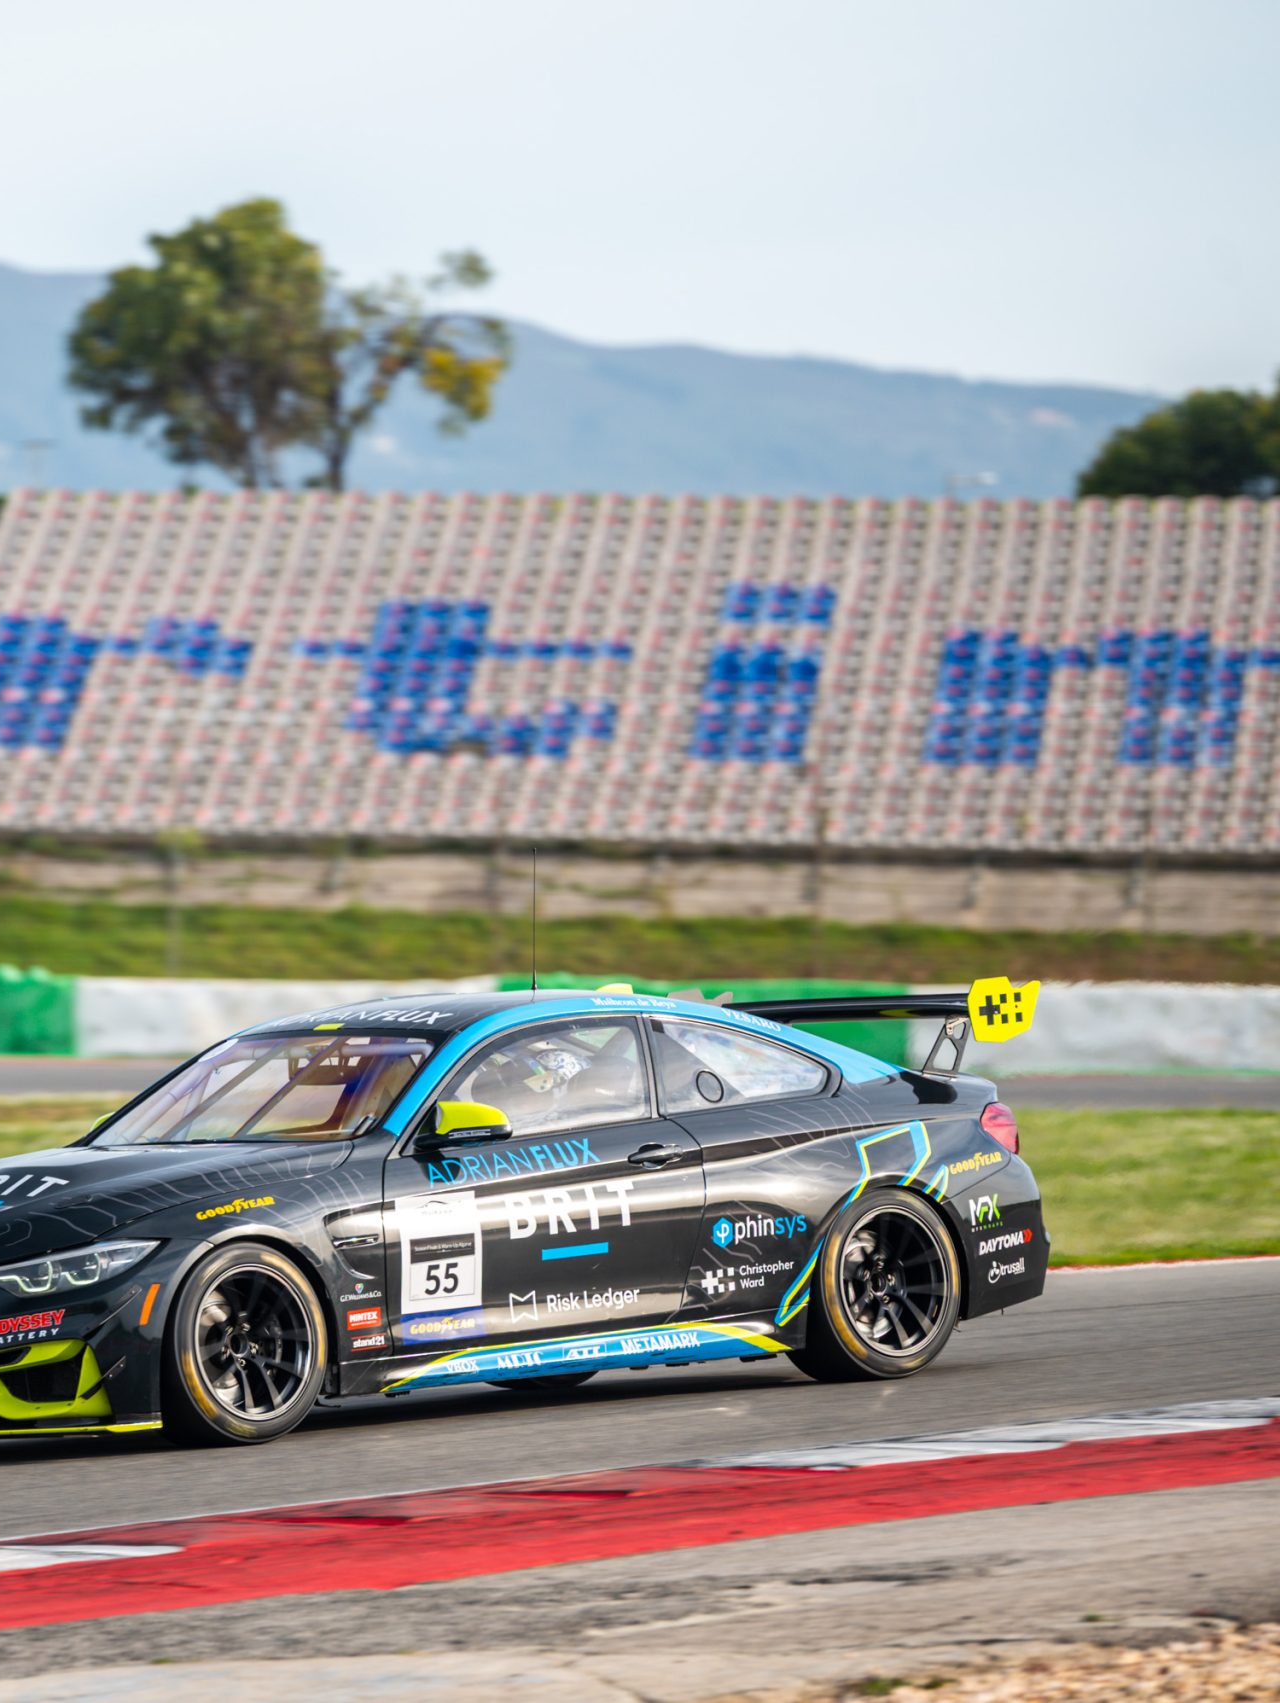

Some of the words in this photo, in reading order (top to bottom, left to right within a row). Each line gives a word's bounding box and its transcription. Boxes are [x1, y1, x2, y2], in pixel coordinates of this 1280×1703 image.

[721, 1007, 783, 1032] VESARO
[426, 1137, 601, 1189] ADRIANFLUX
[950, 1151, 1002, 1175] GOODYEAR
[196, 1196, 276, 1221] GOODYEAR
[505, 1181, 635, 1240] BRIT
[734, 1213, 807, 1246] phinsys
[979, 1230, 1025, 1256] DAYTONA
[424, 1262, 459, 1296] 55
[739, 1260, 795, 1276] Christopher
[740, 1276, 765, 1290] Ward
[546, 1292, 581, 1313] Risk
[583, 1287, 640, 1310] Ledger
[349, 1311, 378, 1323] MINTEX
[410, 1316, 476, 1335] GOODYEAR
[619, 1332, 701, 1355] METAMARK
